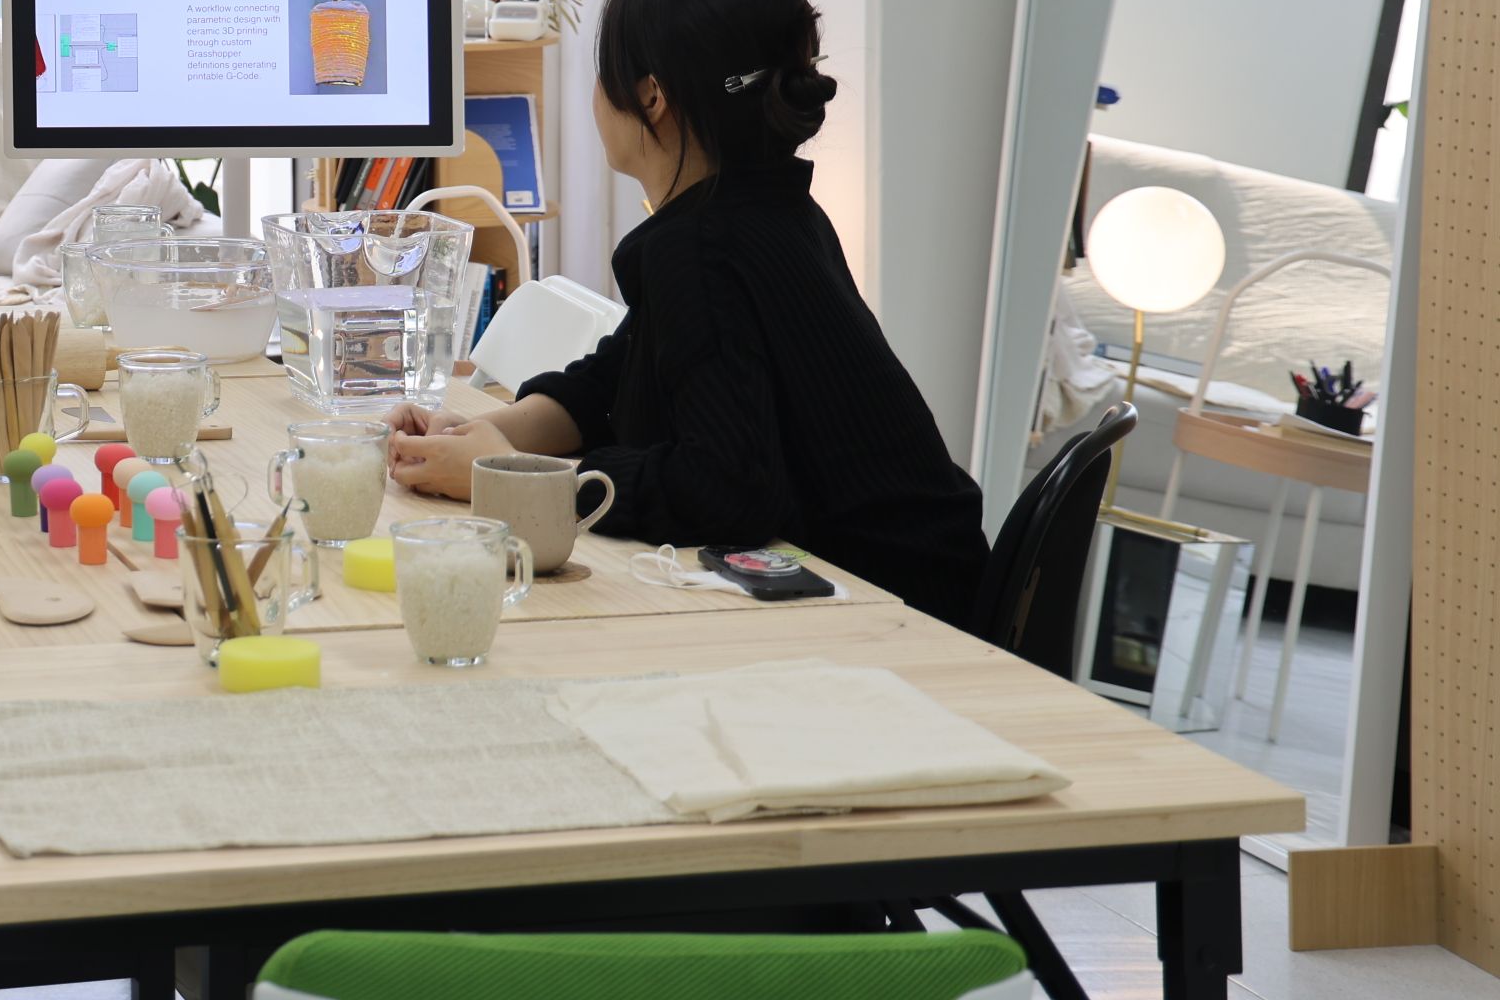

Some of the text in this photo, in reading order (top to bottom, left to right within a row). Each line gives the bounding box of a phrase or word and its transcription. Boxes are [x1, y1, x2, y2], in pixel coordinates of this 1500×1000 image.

[234, 4, 280, 13] connecting
[187, 15, 281, 24] parametric design with
[222, 27, 234, 35] 3D
[237, 27, 268, 36] printing
[187, 39, 218, 47] through
[187, 50, 241, 58] Grasshopper
[188, 61, 277, 70] definitions generating
[188, 72, 223, 81] printable
